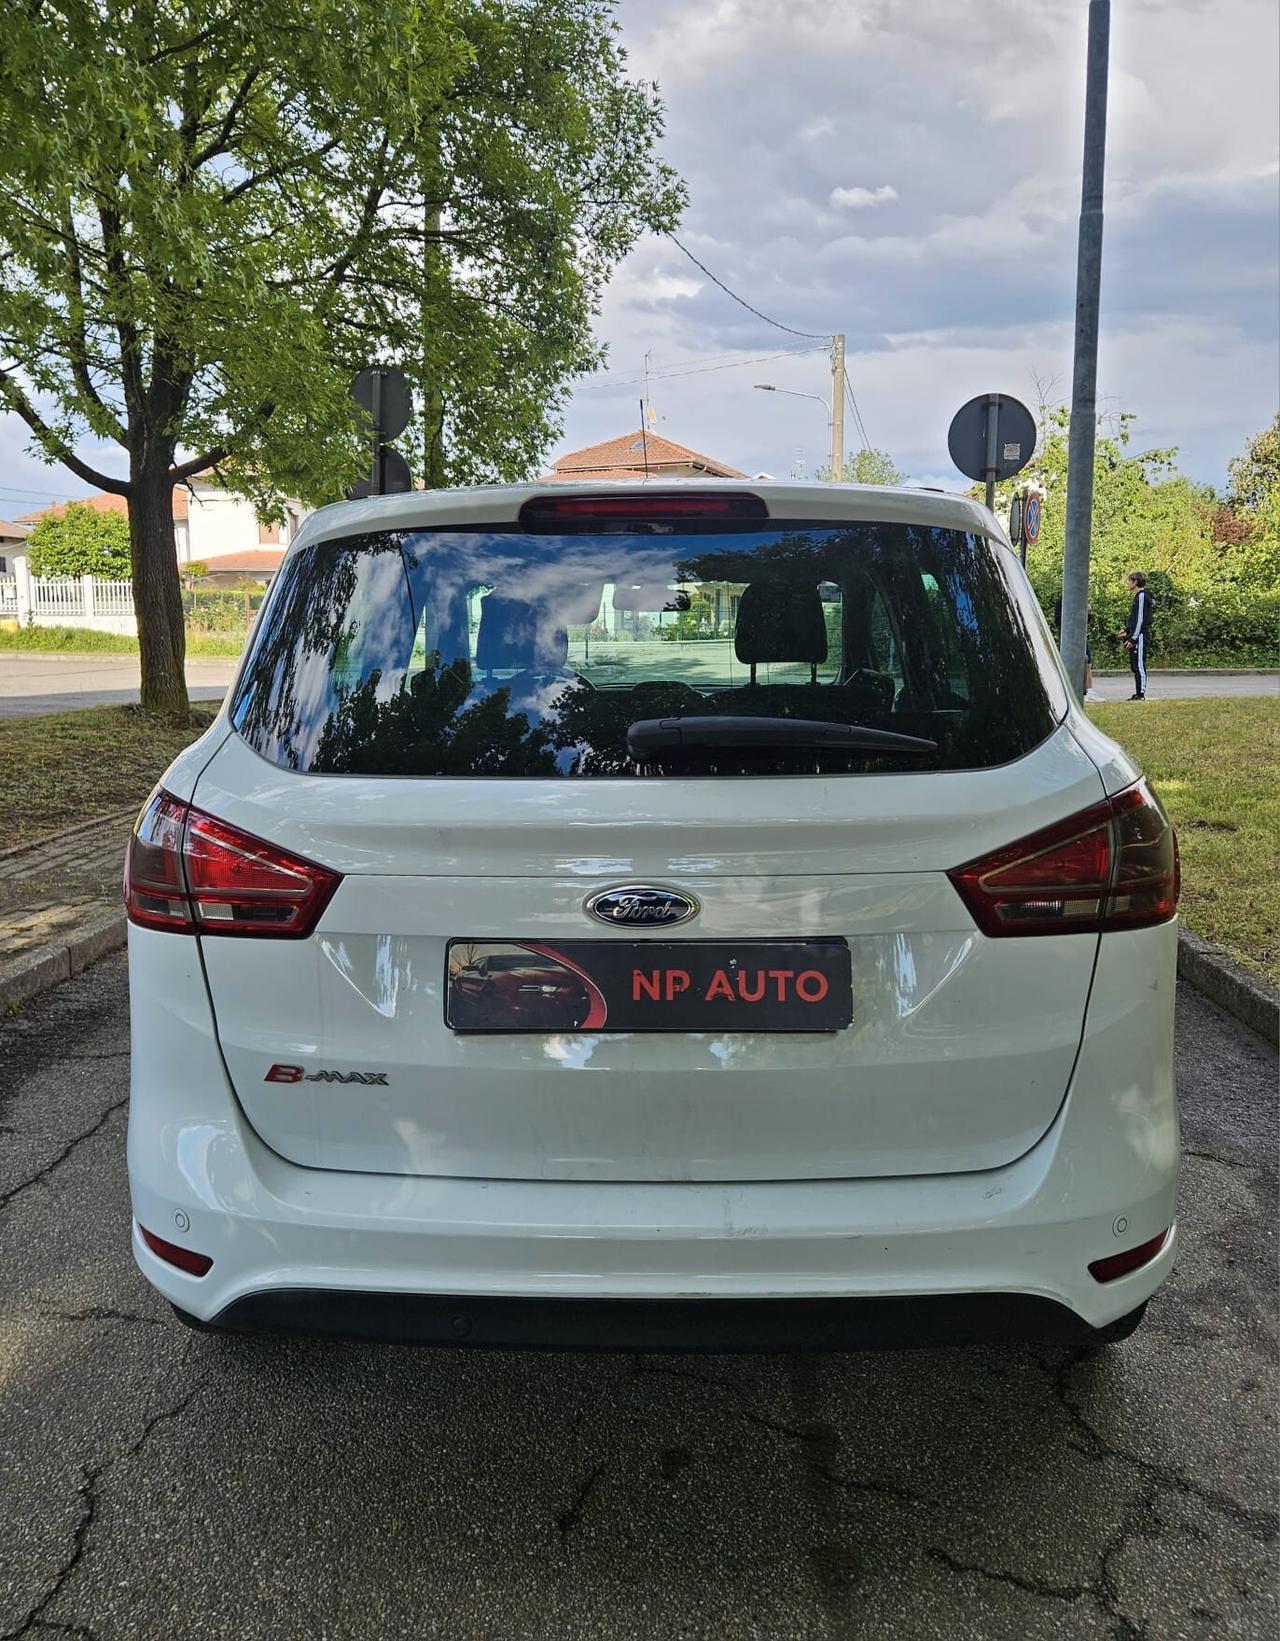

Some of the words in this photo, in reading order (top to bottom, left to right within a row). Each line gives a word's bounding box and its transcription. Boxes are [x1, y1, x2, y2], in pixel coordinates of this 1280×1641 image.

[612, 894, 672, 919] Ford
[632, 970, 691, 1001] NP
[705, 970, 829, 1002] AUTO
[263, 1064, 390, 1086] B-MAX
